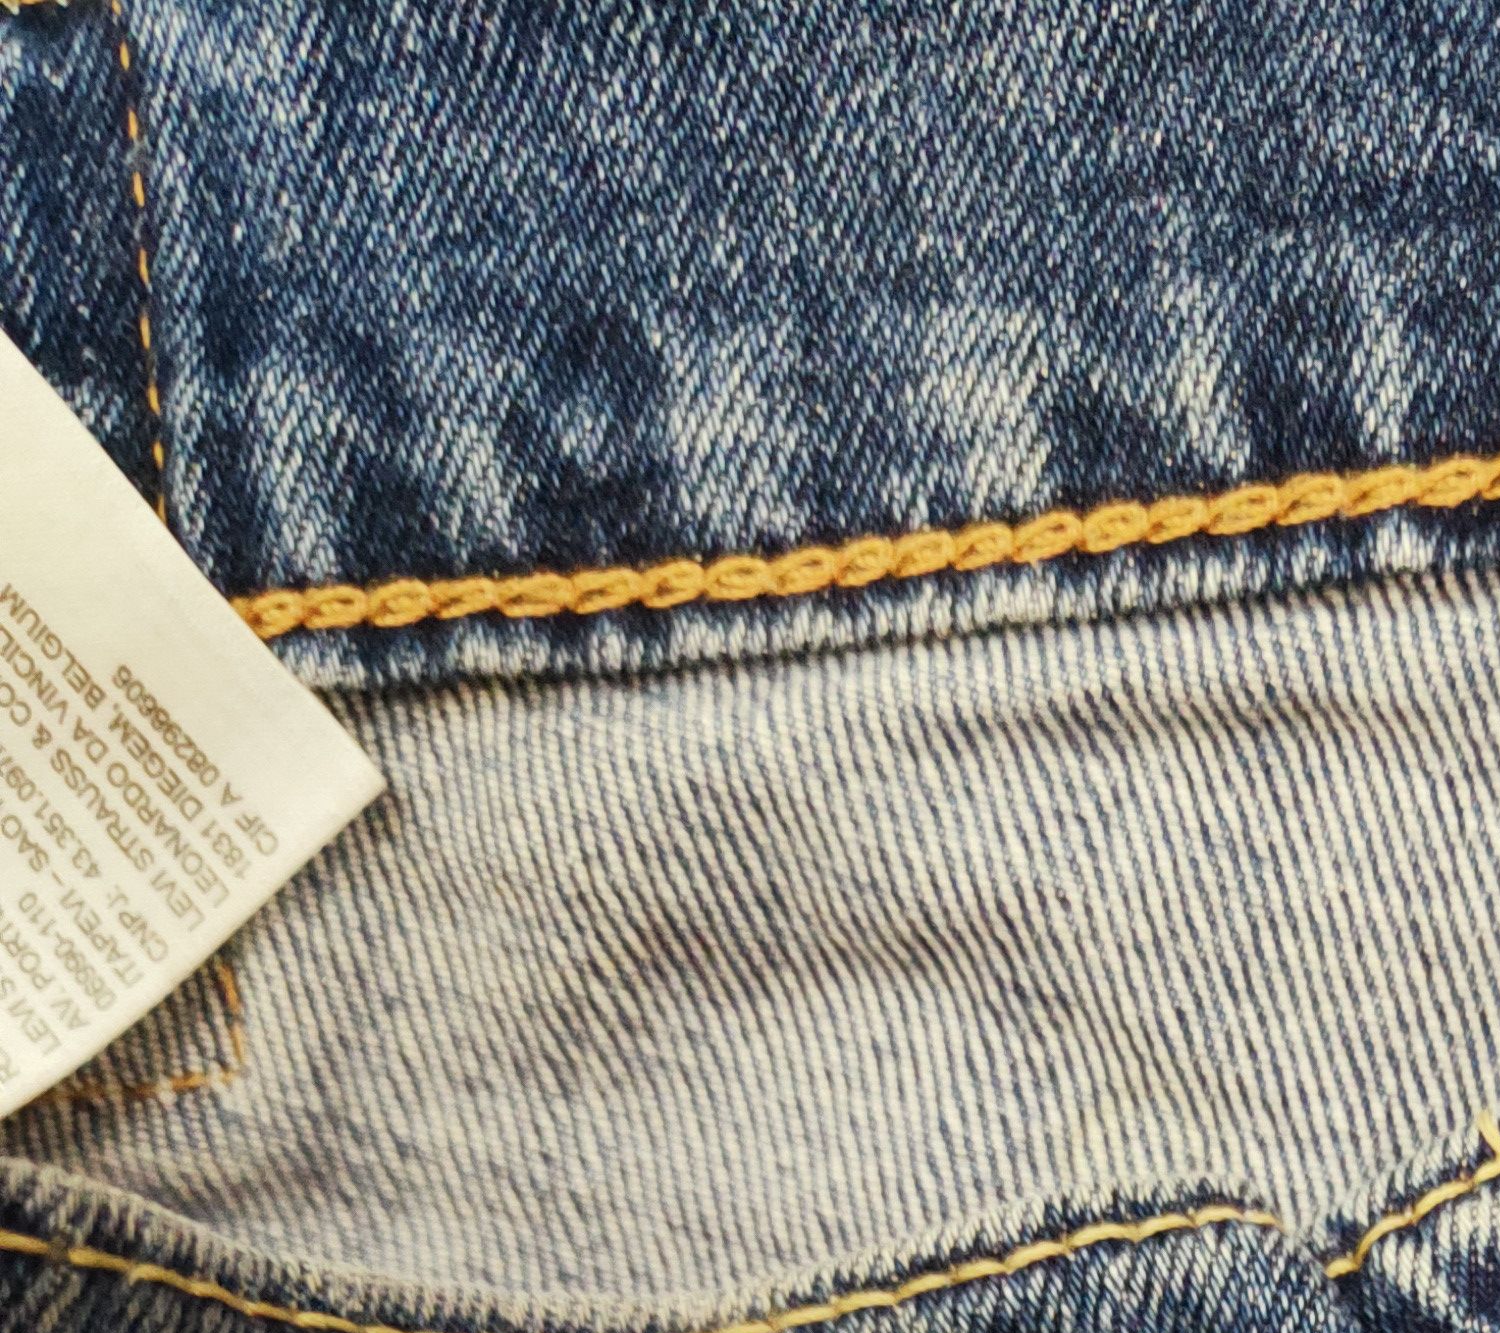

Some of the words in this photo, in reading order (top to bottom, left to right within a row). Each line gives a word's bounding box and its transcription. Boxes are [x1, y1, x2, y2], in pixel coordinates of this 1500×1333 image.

[0, 583, 106, 711] BELGIUM
[32, 721, 52, 749] &
[73, 716, 109, 764] DA
[0, 744, 100, 877] 43.351.097
[50, 748, 154, 872] STRAUSS
[220, 781, 243, 807] A
[107, 763, 230, 908] LEONARDO
[200, 818, 250, 879] 1831
[234, 813, 279, 856] CIF
[150, 869, 205, 932] LEVI
[0, 908, 56, 989] PORT
[60, 888, 144, 988] ITAPEVI
